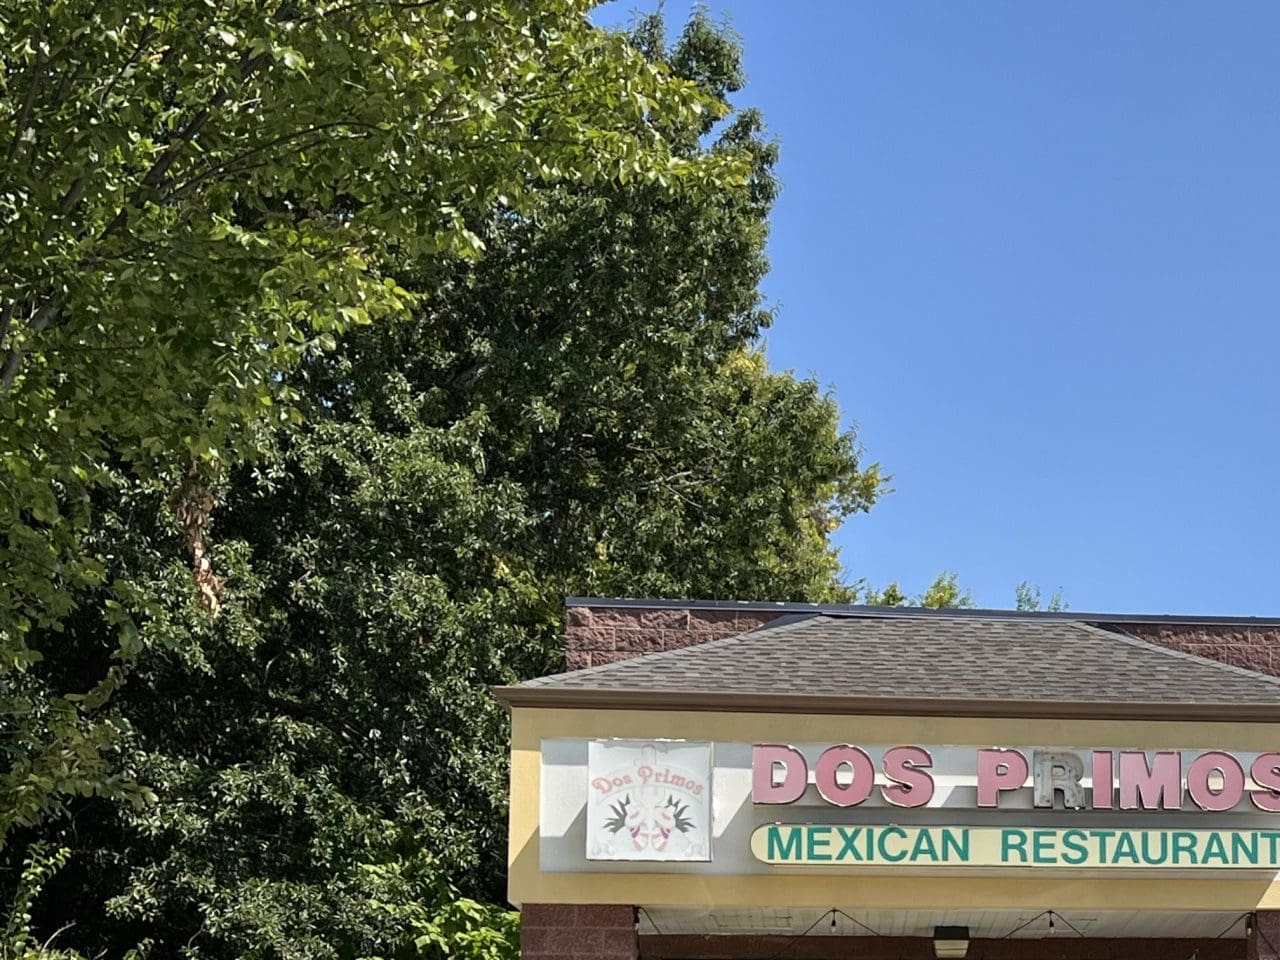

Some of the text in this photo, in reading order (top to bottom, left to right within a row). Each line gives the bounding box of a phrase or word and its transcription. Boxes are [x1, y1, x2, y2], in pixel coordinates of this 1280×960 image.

[591, 764, 705, 796] Dos Primos
[751, 743, 936, 808] DOS
[766, 825, 970, 862] MEXICAN
